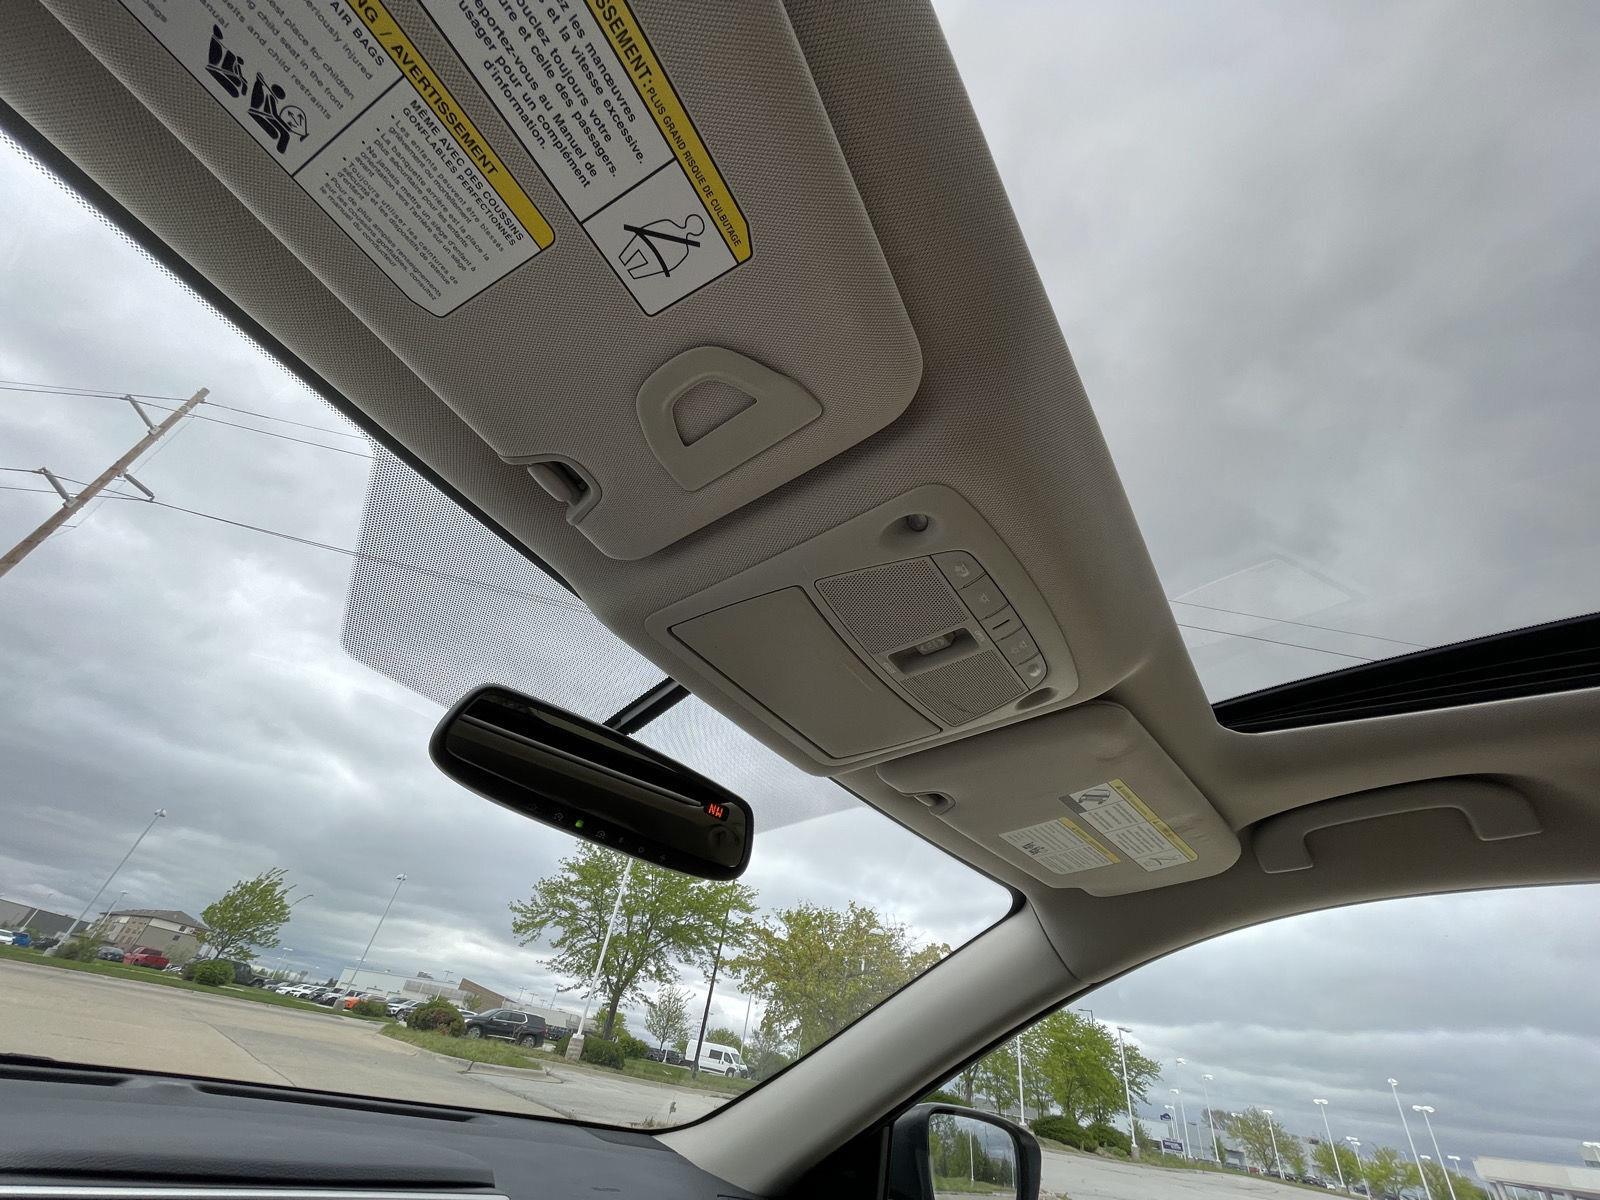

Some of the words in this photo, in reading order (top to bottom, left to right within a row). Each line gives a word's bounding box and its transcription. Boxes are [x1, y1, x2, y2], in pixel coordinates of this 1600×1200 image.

[245, 23, 267, 46] and
[265, 45, 292, 74] child
[289, 72, 333, 120] restraints
[255, 9, 281, 37] child
[278, 36, 301, 60] seat
[298, 58, 311, 71] in
[307, 69, 325, 87] the
[322, 85, 345, 110] front
[265, 0, 286, 18] est
[282, 16, 311, 47] place
[308, 45, 324, 62] for
[320, 60, 357, 100] children
[301, 0, 343, 44] eriously
[340, 43, 374, 81] injured
[328, 0, 353, 26] AIR
[350, 26, 386, 67] BAGS
[566, 13, 588, 39] les
[582, 41, 638, 123] manœuvres
[390, 40, 499, 178] AVERTISSEMENT
[455, 0, 497, 54] usager
[493, 54, 523, 91] pour
[520, 91, 538, 111] un
[533, 112, 592, 189] complément
[481, 57, 551, 150] d'information.
[516, 24, 532, 42] et
[528, 42, 557, 79] celle
[553, 80, 576, 108] des
[570, 110, 621, 178] passagers.
[537, 92, 554, 112] au
[551, 113, 587, 159] Manuel
[582, 159, 600, 177] de
[545, 5, 561, 25] et
[557, 25, 573, 42] la
[568, 44, 606, 96] vitesse
[600, 97, 648, 164] excessive.
[546, 47, 591, 108] toujours
[587, 108, 614, 143] votre
[401, 106, 458, 173] GONFLABLES
[409, 98, 442, 136] MÊME
[438, 135, 466, 167] AVEC
[463, 167, 484, 190] DES
[481, 190, 525, 241] COUSSINS
[643, 87, 667, 115] PLUS
[661, 117, 687, 151] GRAND
[680, 151, 707, 185] RISQUE
[701, 184, 714, 198] DE
[708, 197, 742, 247] CULBUTAGE
[708, 803, 724, 818] NW
